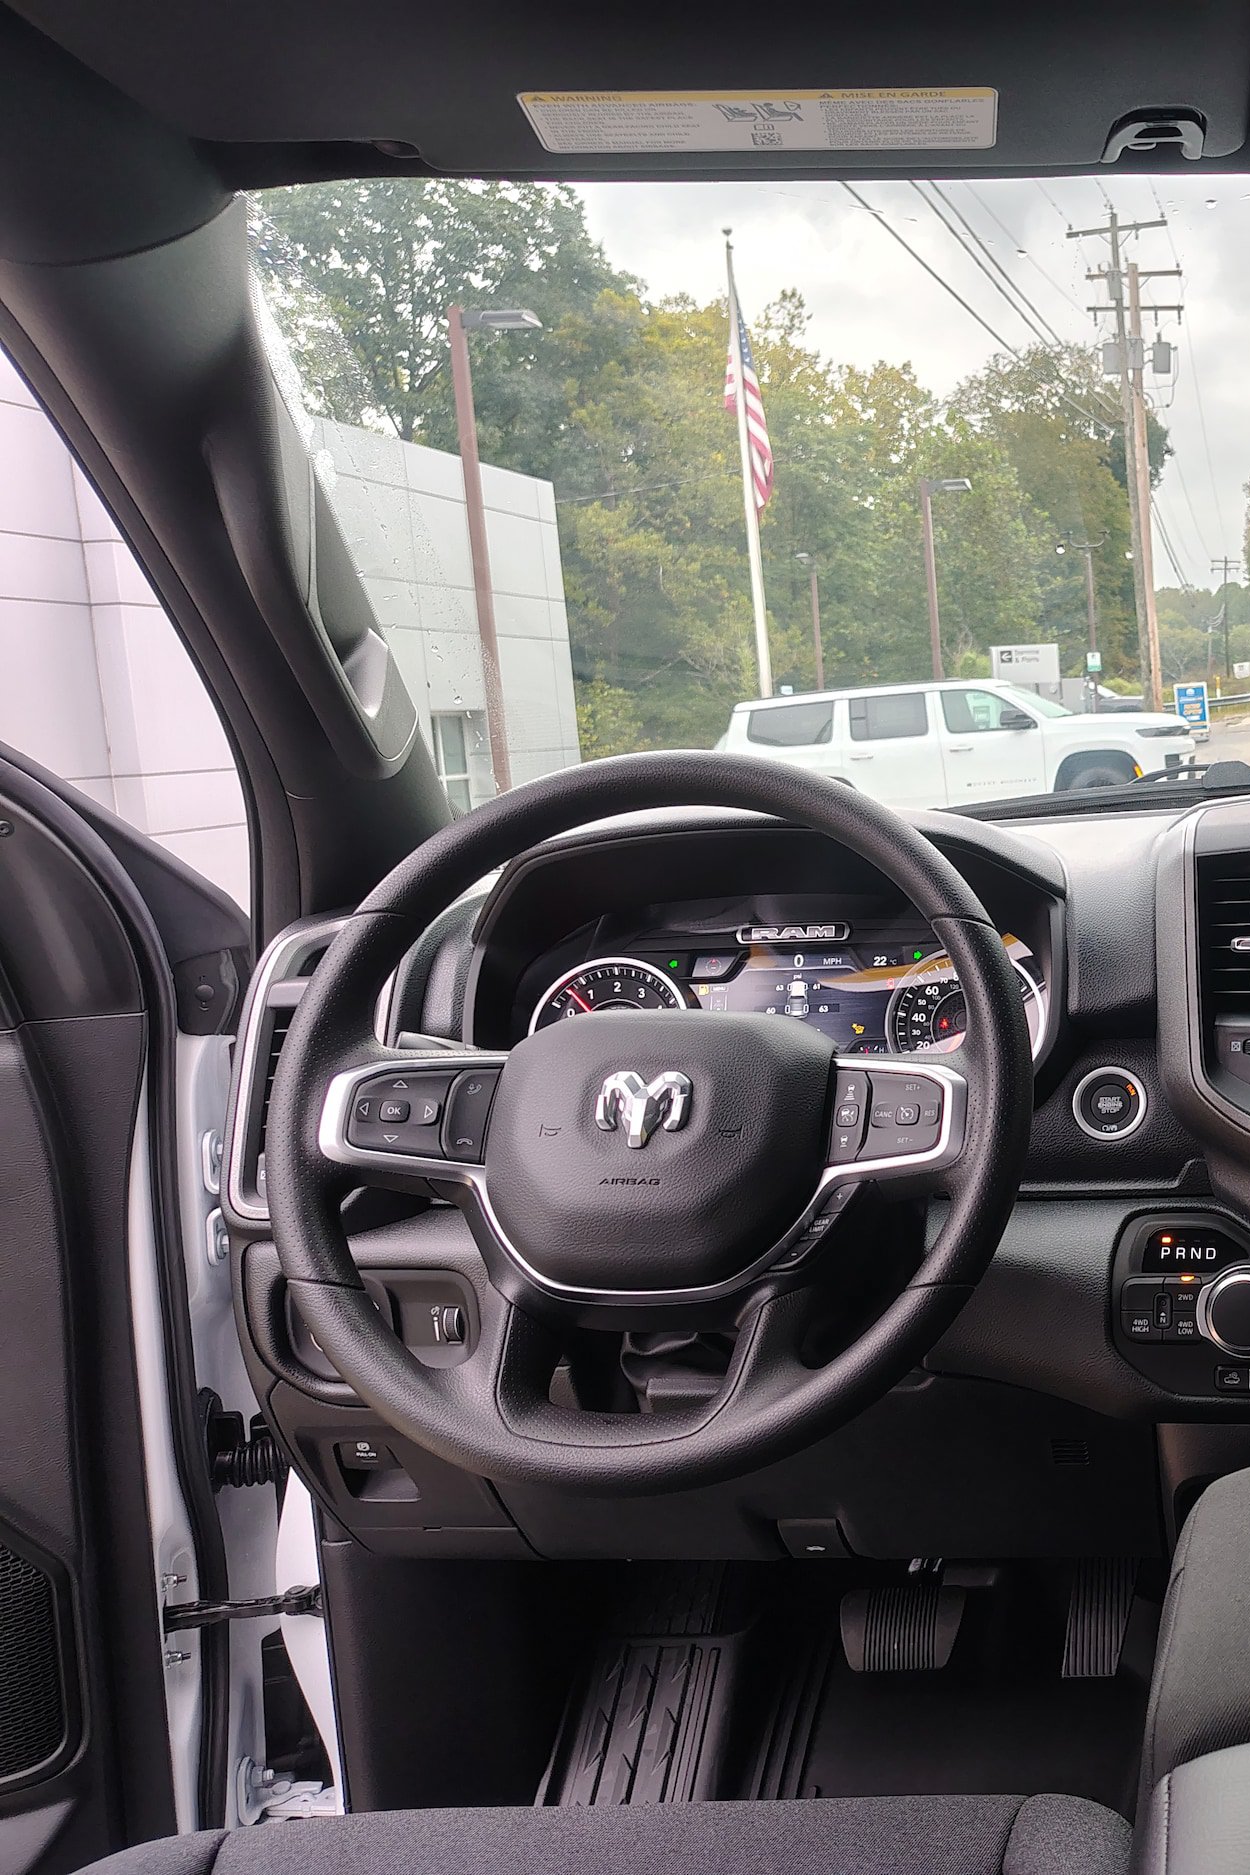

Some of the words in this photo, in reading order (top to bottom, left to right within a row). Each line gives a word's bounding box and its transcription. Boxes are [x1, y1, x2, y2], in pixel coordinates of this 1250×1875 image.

[752, 925, 836, 940] RAM
[793, 954, 804, 967] 0
[823, 957, 842, 965] MPH
[873, 956, 887, 966] 22
[613, 981, 622, 992] 2
[925, 985, 939, 996] 60
[587, 989, 594, 1000] 1
[638, 988, 646, 998] 3
[766, 1007, 776, 1015] 60
[818, 1004, 829, 1013] 63
[911, 1012, 926, 1023] 40
[916, 1041, 930, 1050] 20
[905, 1083, 921, 1091] SET+
[387, 1105, 401, 1115] OK
[874, 1110, 893, 1118] CANC
[924, 1109, 936, 1117] RES
[599, 1178, 661, 1186] AIRBAG
[813, 1218, 830, 1226] GEAR
[808, 1225, 825, 1233] LIMIT
[1177, 1293, 1194, 1301] 2WD
[1177, 1327, 1194, 1335] LOW
